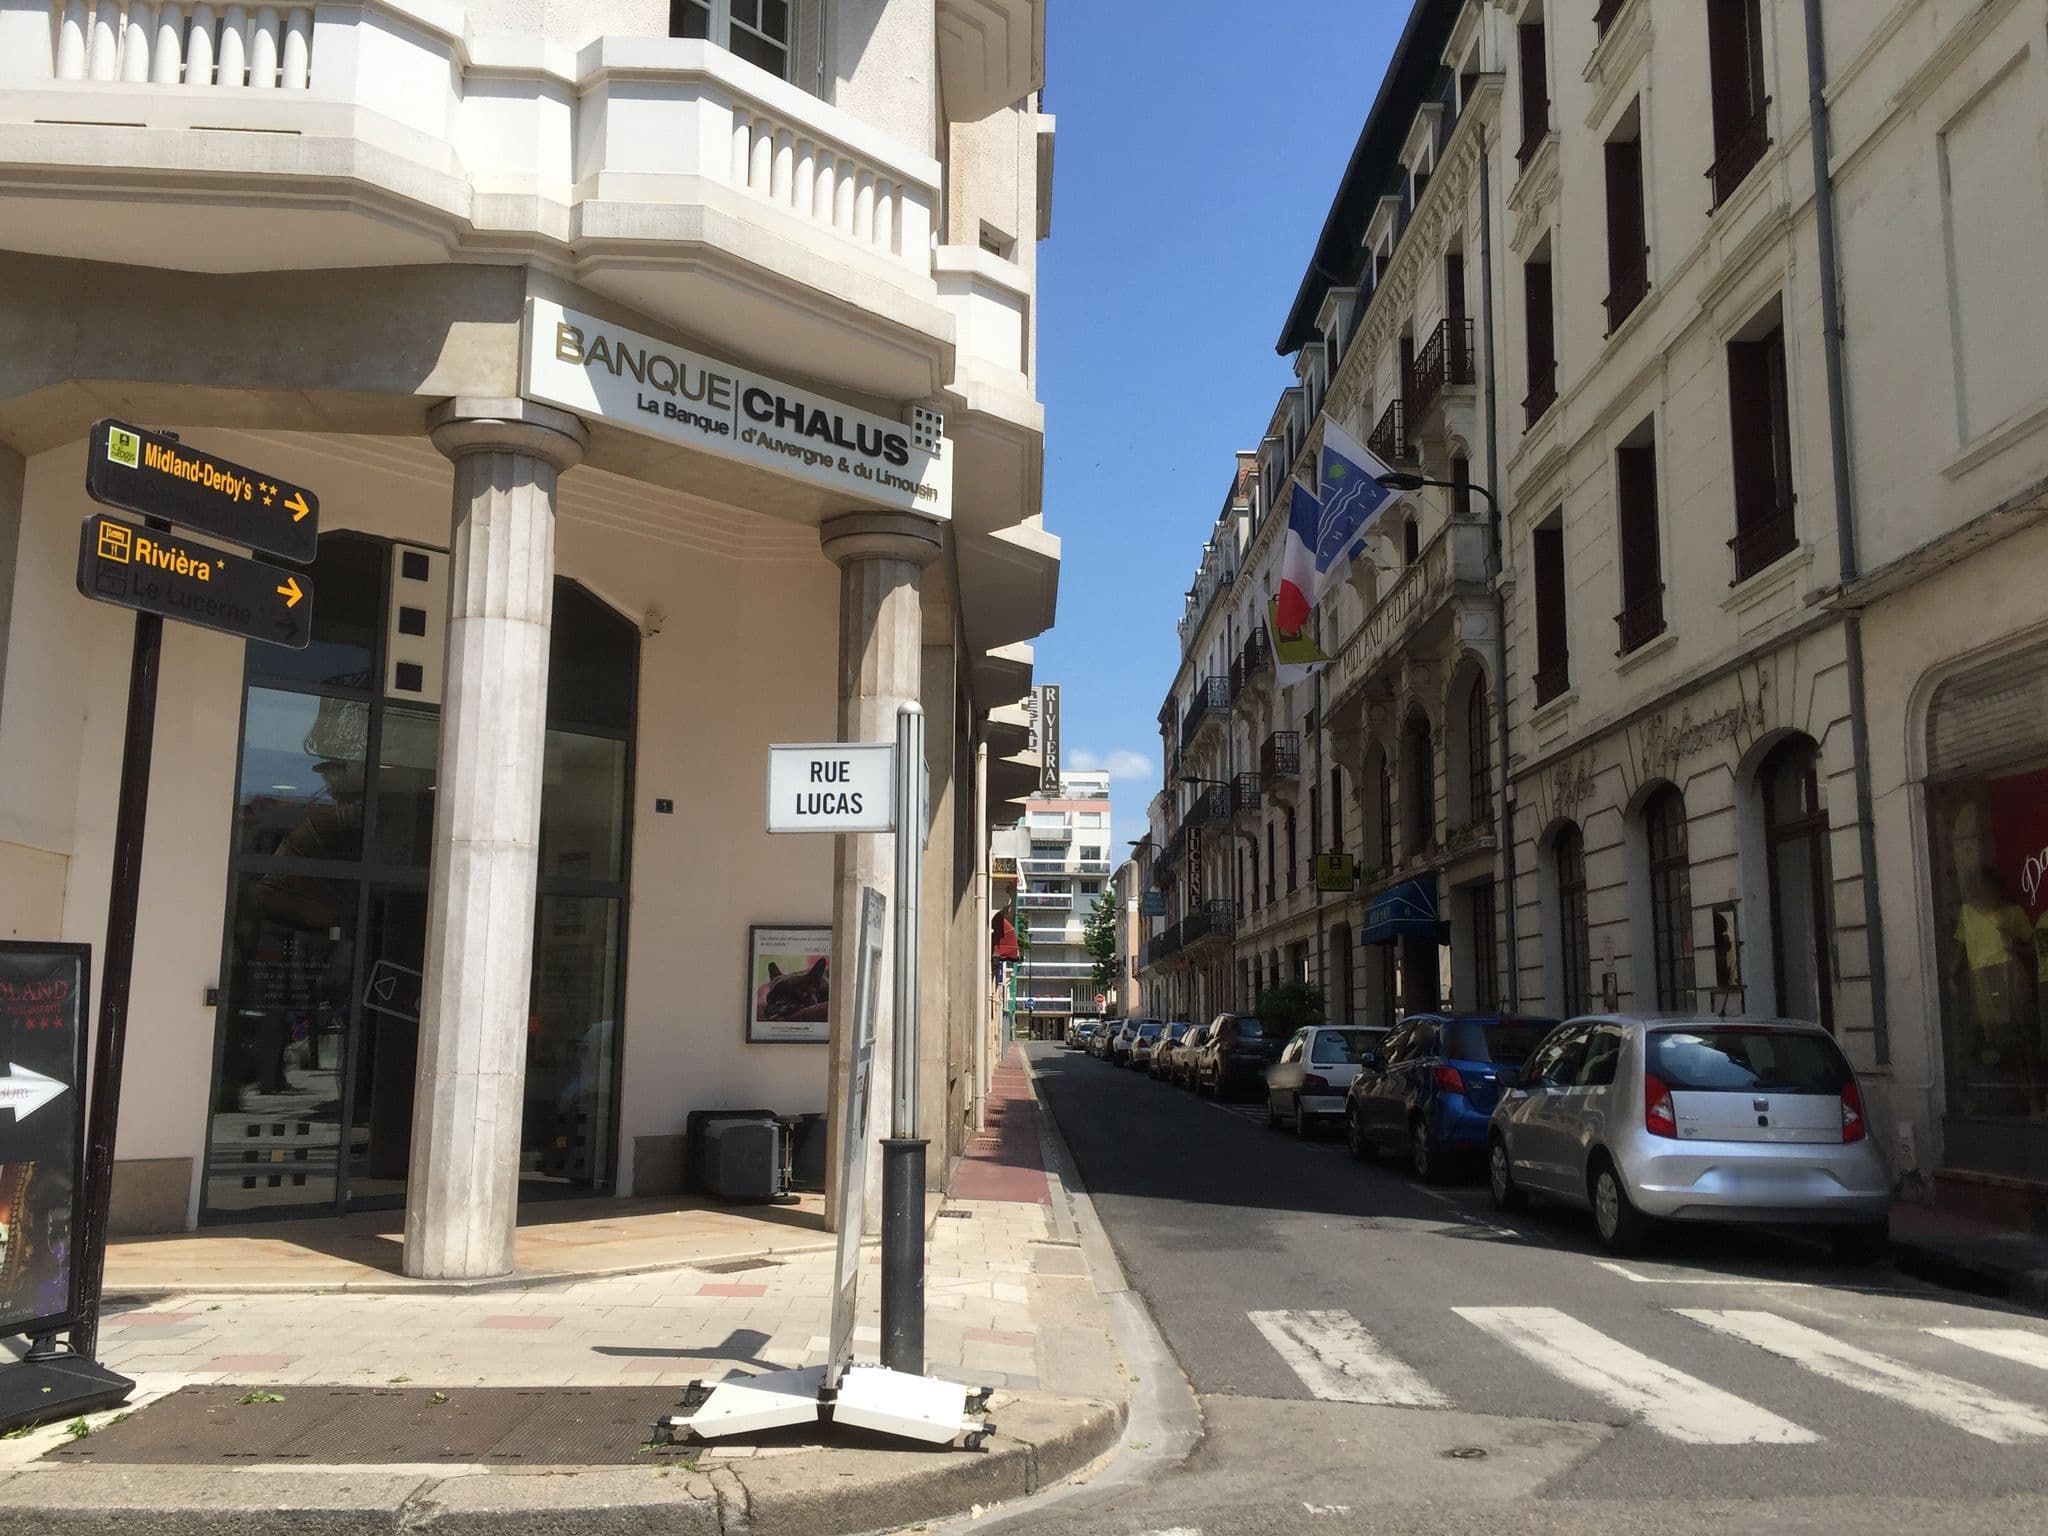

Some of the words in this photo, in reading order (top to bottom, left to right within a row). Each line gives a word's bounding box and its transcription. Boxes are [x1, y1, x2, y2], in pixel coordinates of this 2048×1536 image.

[556, 321, 732, 412] BANQUE
[742, 387, 910, 467] CHALUS
[144, 441, 253, 503] Midland-Derby's
[637, 392, 661, 416] La
[663, 401, 730, 436] Banque
[741, 425, 835, 472] d'Auvergne
[837, 457, 850, 473] &
[853, 460, 873, 481] du
[876, 467, 939, 504] Limousin
[131, 571, 160, 600] Le
[134, 537, 211, 582] Rivièra
[1045, 687, 1057, 782] RIVIERA
[810, 760, 850, 783] RUE
[796, 792, 863, 815] LUCAS
[1189, 828, 1201, 907] LUCERNE
